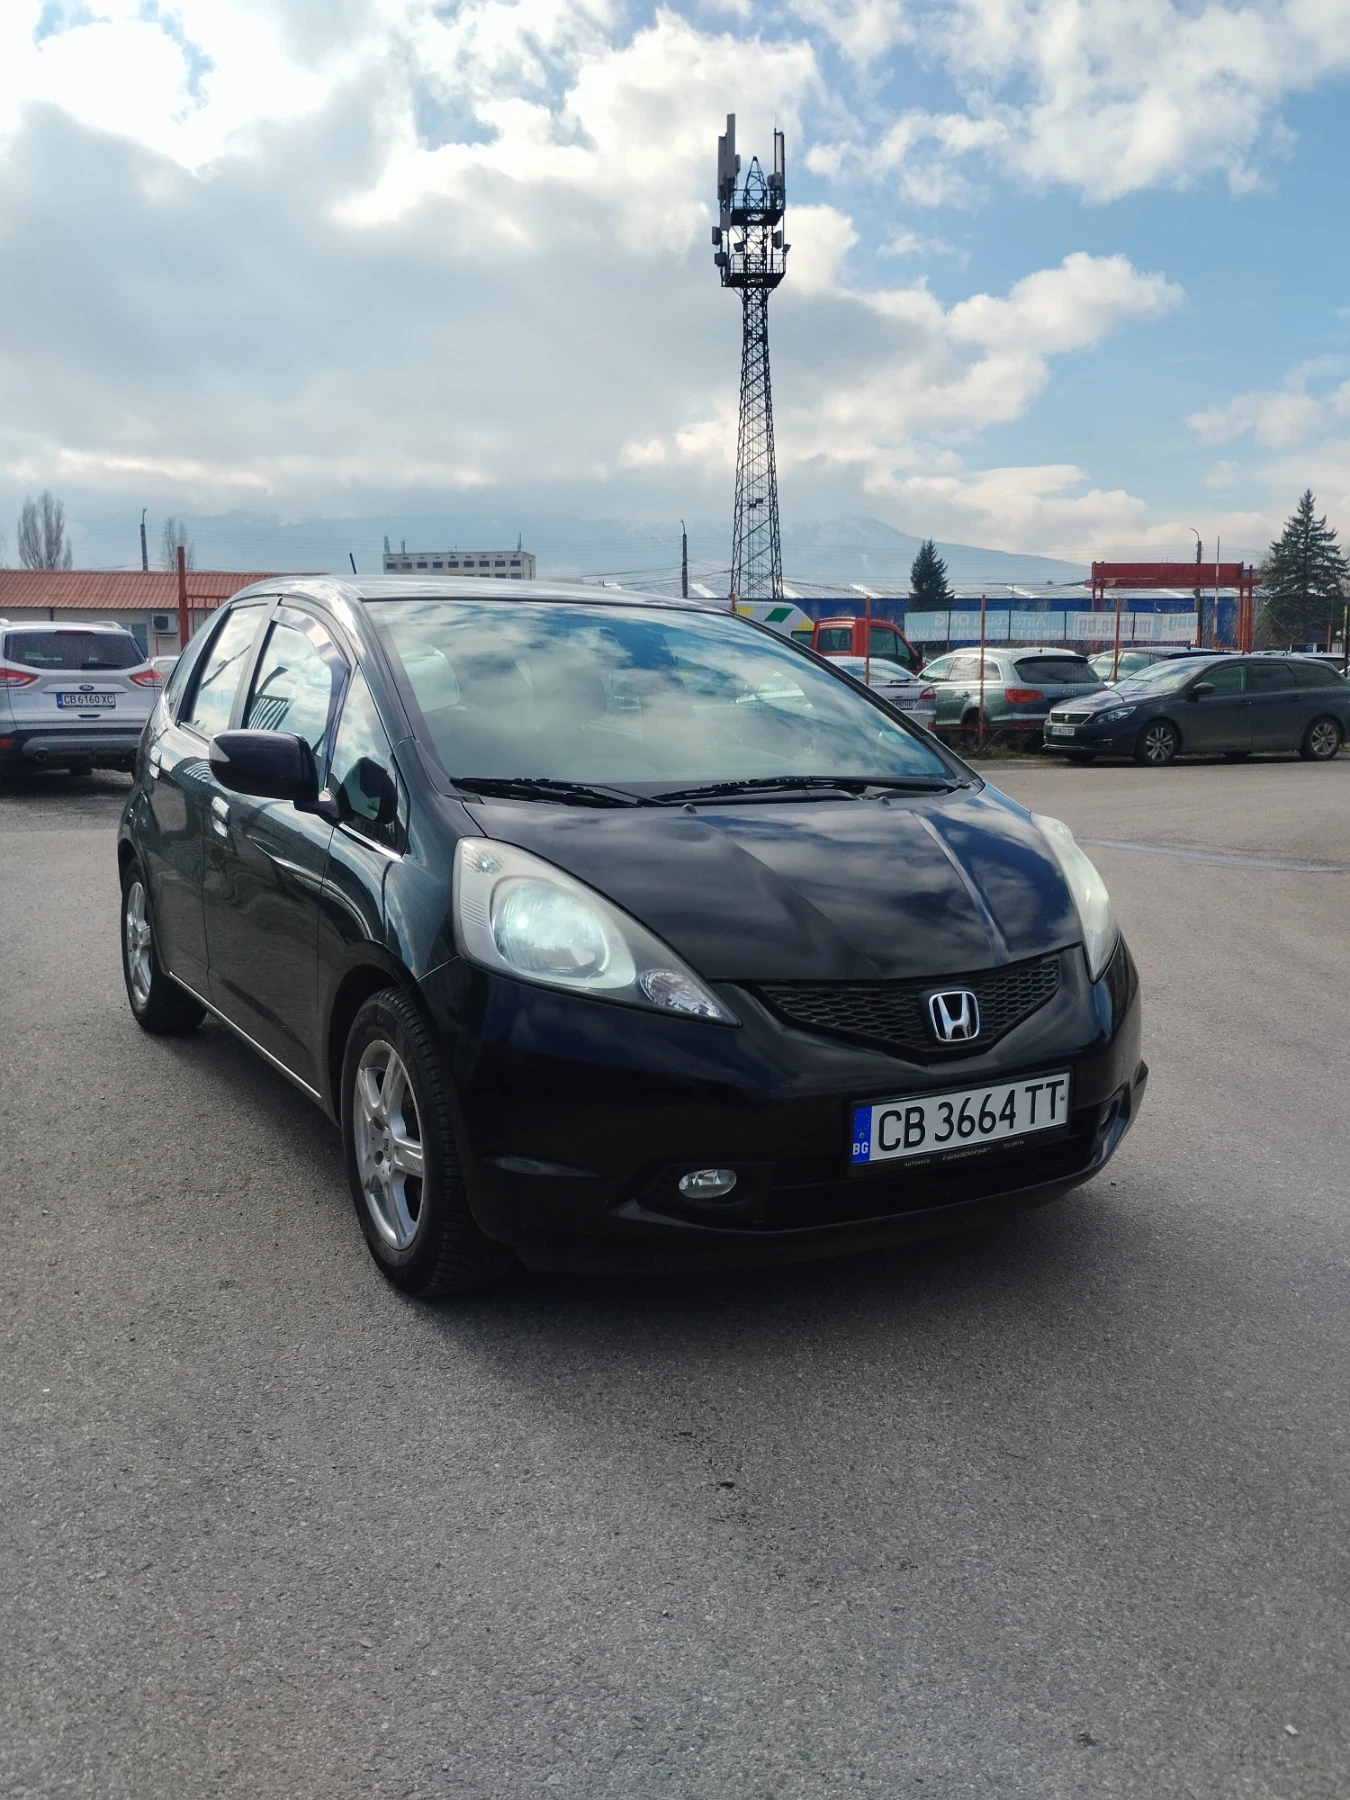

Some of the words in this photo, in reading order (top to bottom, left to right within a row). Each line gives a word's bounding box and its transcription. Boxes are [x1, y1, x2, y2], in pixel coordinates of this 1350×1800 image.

[63, 695, 77, 704] CB
[78, 695, 100, 704] 6160
[101, 695, 114, 704] XC
[878, 1106, 926, 1152] CB
[934, 1089, 1016, 1142] 3664
[1025, 1079, 1065, 1125] TT
[852, 1142, 869, 1156] BG
